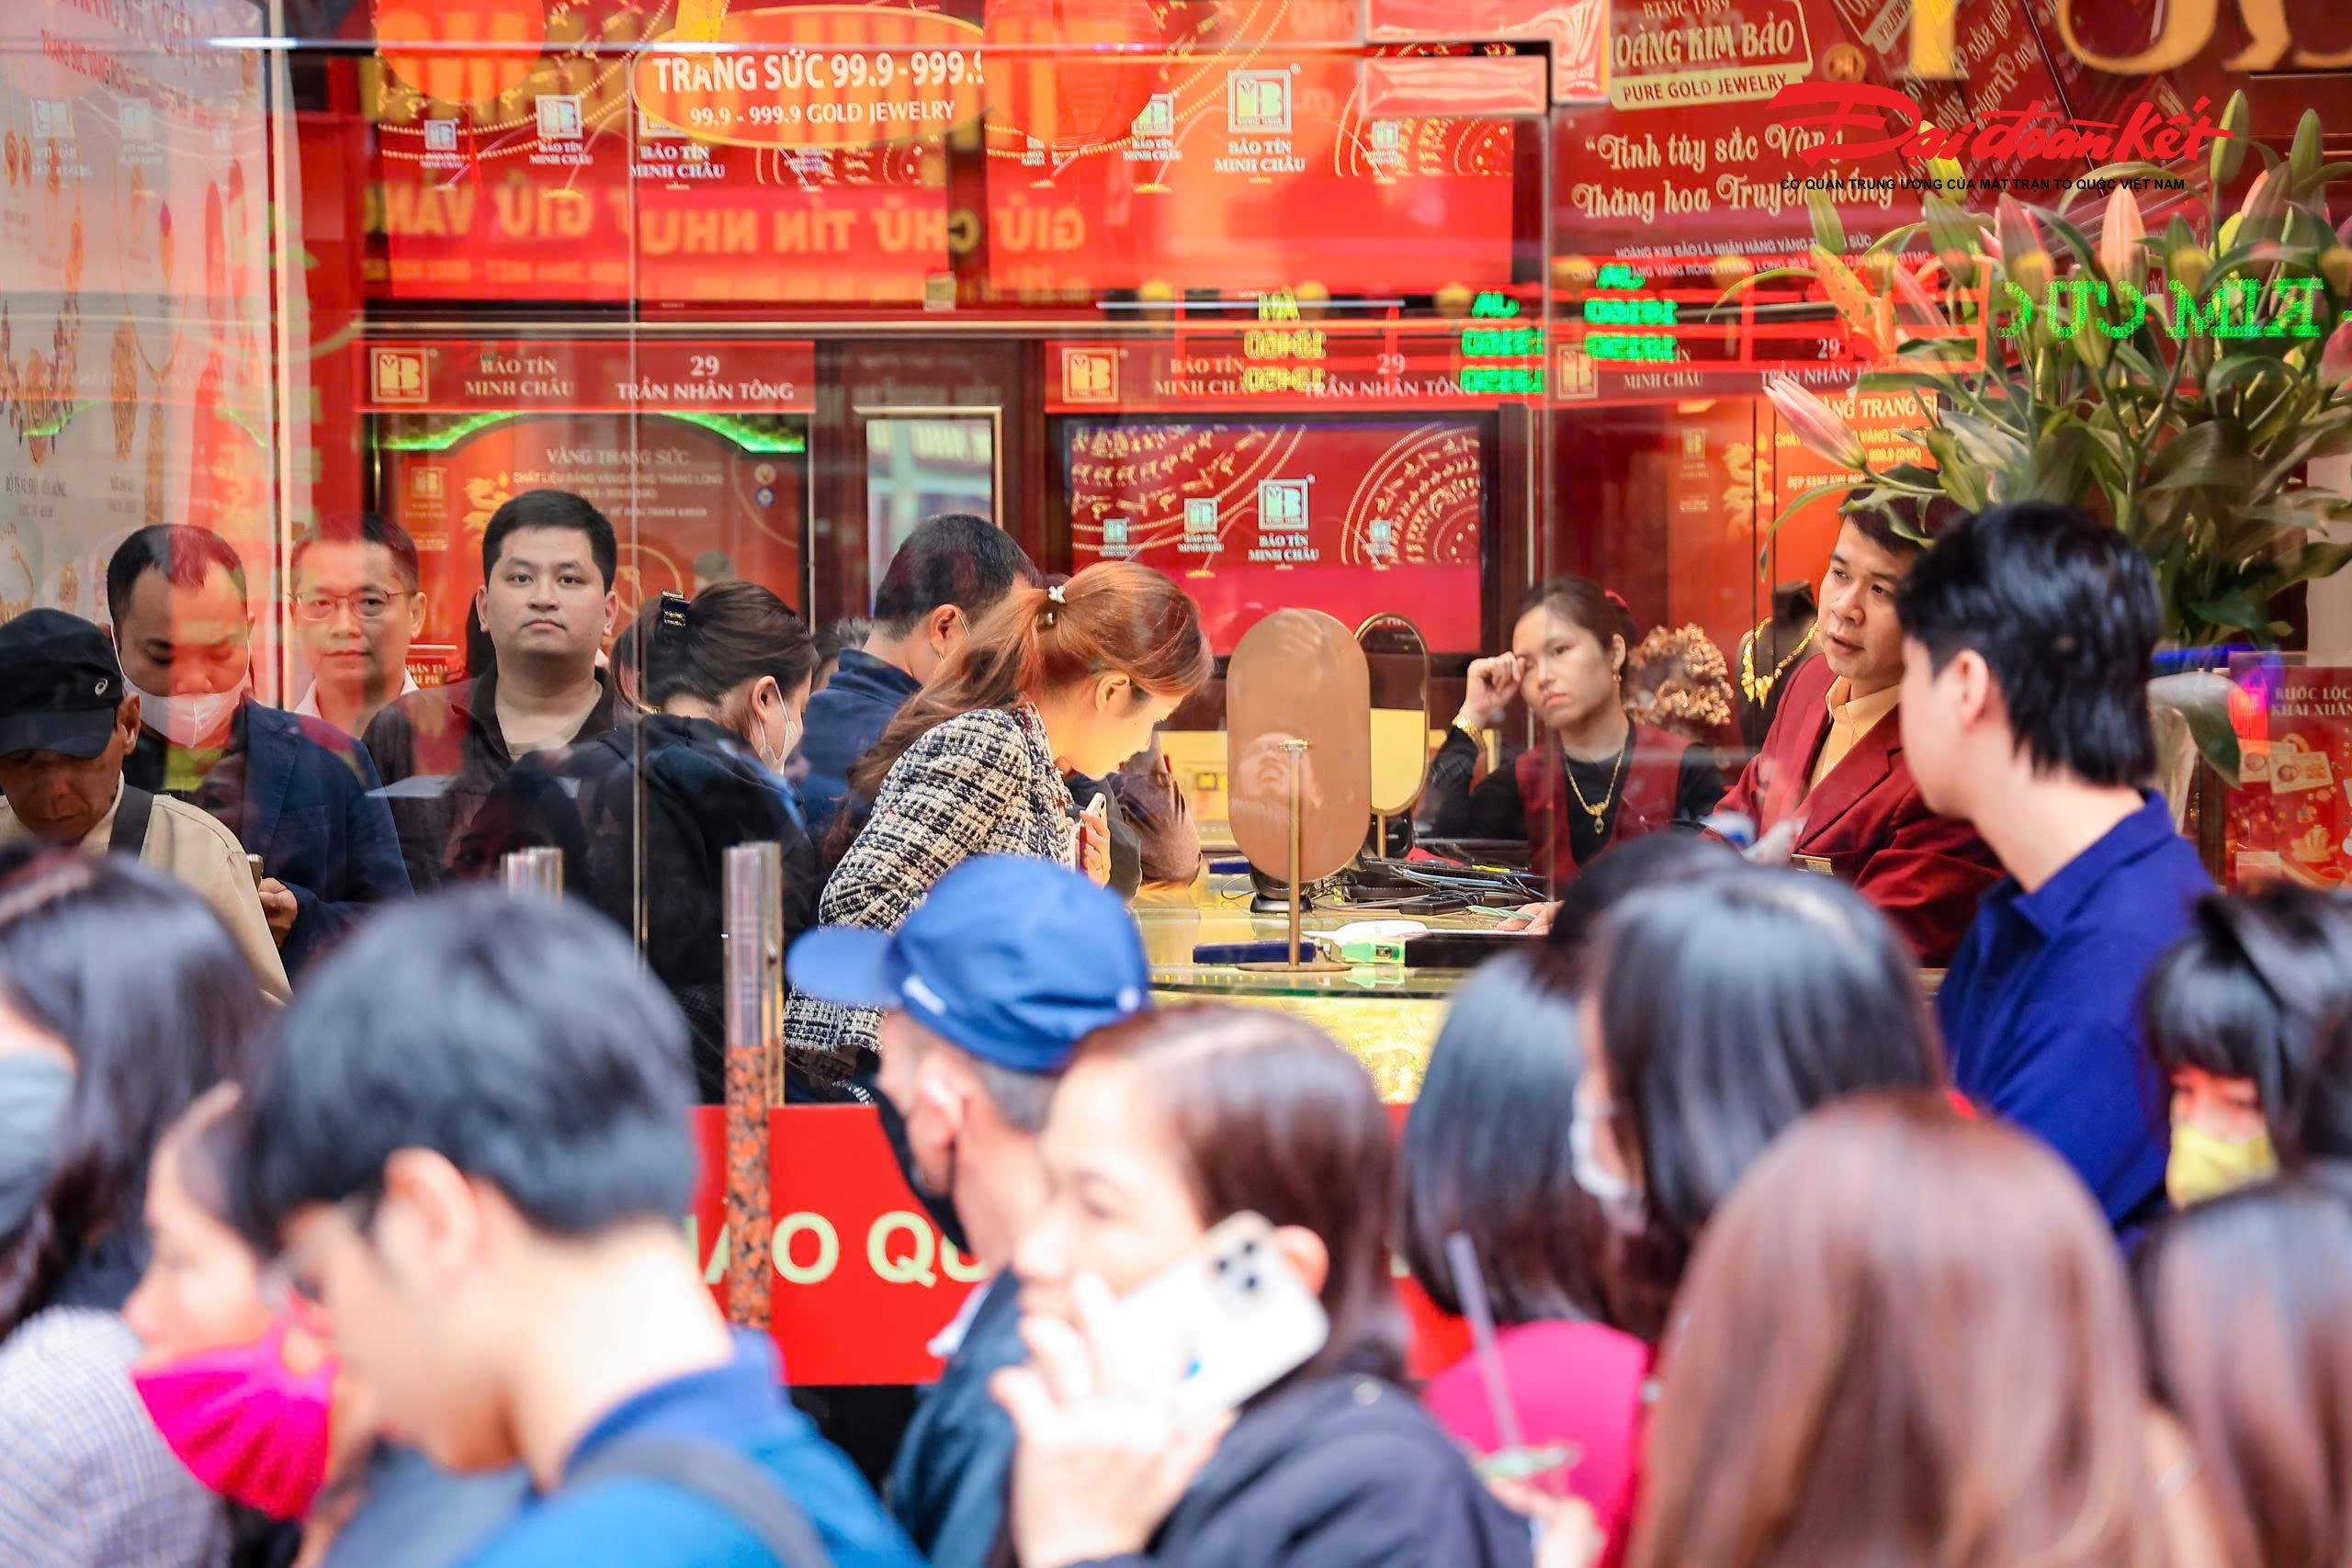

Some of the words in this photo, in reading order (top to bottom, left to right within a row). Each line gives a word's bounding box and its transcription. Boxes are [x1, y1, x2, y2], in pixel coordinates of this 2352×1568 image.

[1687, 24, 1736, 62] KIM
[1741, 12, 1794, 57] BẢO
[651, 53, 757, 93] TRANG
[763, 48, 825, 90] SỨC
[1623, 82, 1663, 103] PURE
[1668, 78, 1713, 98] GOLD
[1717, 73, 1787, 96] JEWELRY
[690, 107, 731, 127] 99.9
[750, 104, 801, 126] 999.9
[806, 103, 863, 122] GOLD
[869, 100, 956, 123] JEWELRY
[680, 141, 709, 160] TÍN
[1263, 137, 1292, 154] TÍN
[1714, 125, 1758, 163] sắc
[629, 164, 674, 178] MINH
[676, 161, 726, 178] CHÂU
[1664, 180, 1711, 213] hoa
[1777, 235, 1808, 253] VÀNG
[1816, 337, 1839, 359] 29
[525, 355, 558, 374] TÍN
[689, 355, 720, 377] 29
[1377, 353, 1406, 374] 29
[1804, 361, 1851, 385] NHÂN
[466, 382, 516, 397] MINH
[520, 378, 575, 398] CHÂU
[616, 376, 669, 400] TRẦN
[673, 378, 733, 400] NHÂN
[738, 378, 794, 400] TÔNG
[1154, 378, 1204, 396] MINH
[1361, 376, 1419, 398] NHÂN
[1859, 396, 1918, 419] TRANG
[655, 446, 689, 466] SỨC
